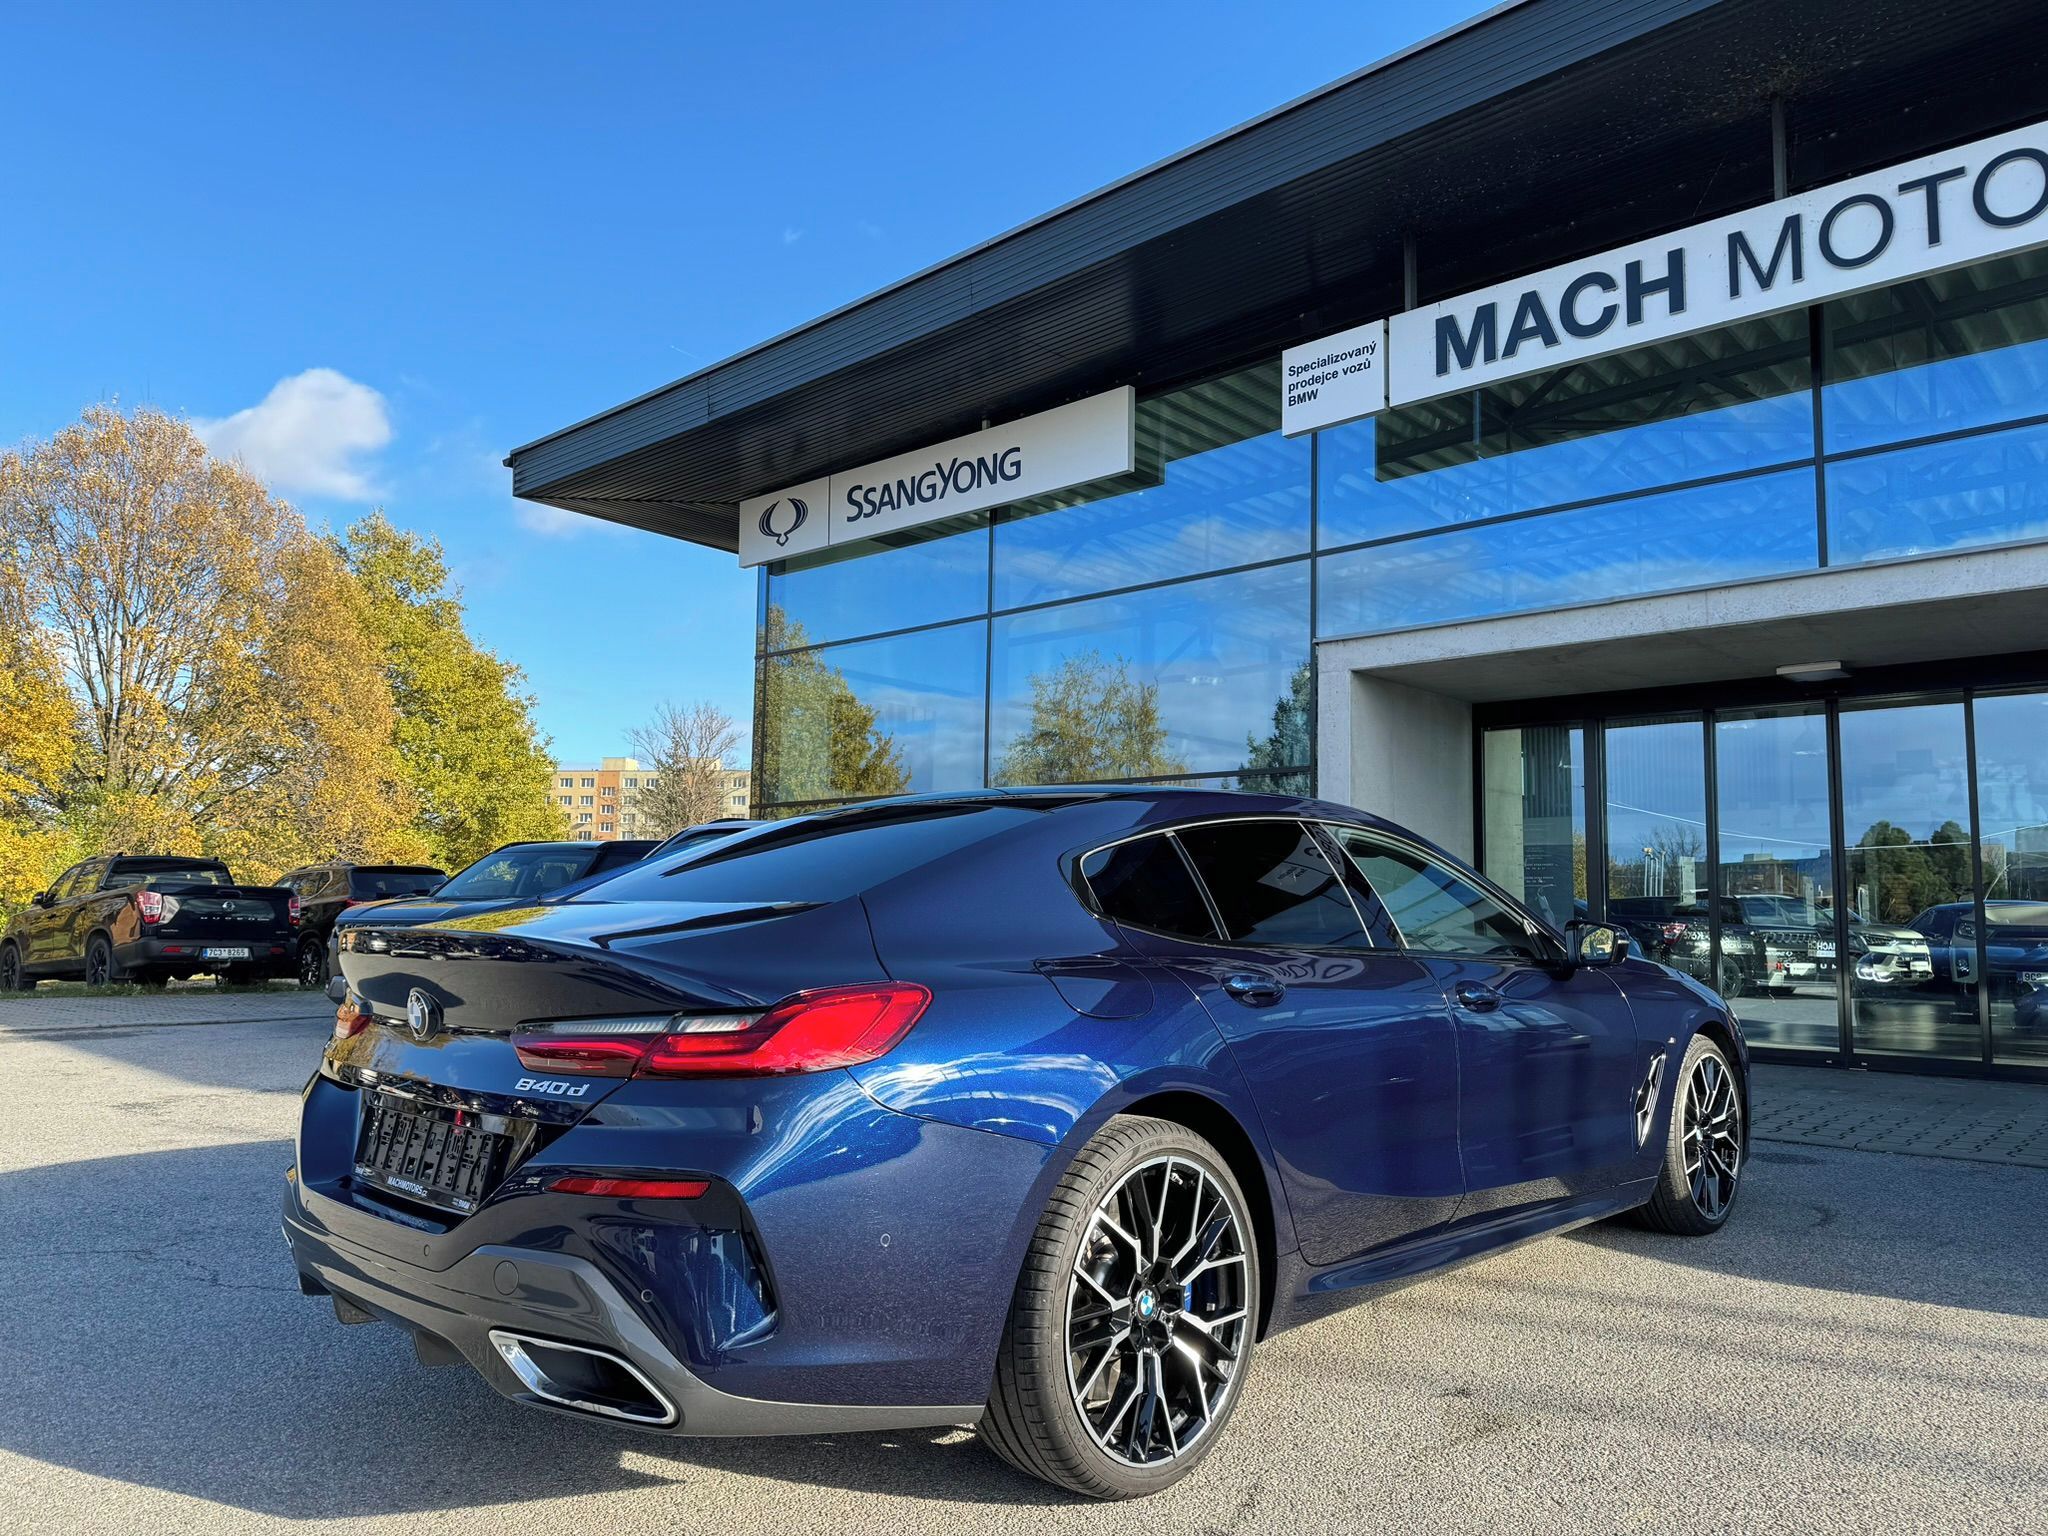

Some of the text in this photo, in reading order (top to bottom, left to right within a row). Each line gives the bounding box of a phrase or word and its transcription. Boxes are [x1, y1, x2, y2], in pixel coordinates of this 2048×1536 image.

[1434, 147, 2048, 377] MACH MOTO
[1288, 341, 1377, 377] Specializovaný
[1288, 358, 1371, 394] prodejce vozů
[1288, 389, 1319, 407] BMW
[846, 446, 1022, 522] SSANGYONG
[514, 1078, 590, 1097] 840d
